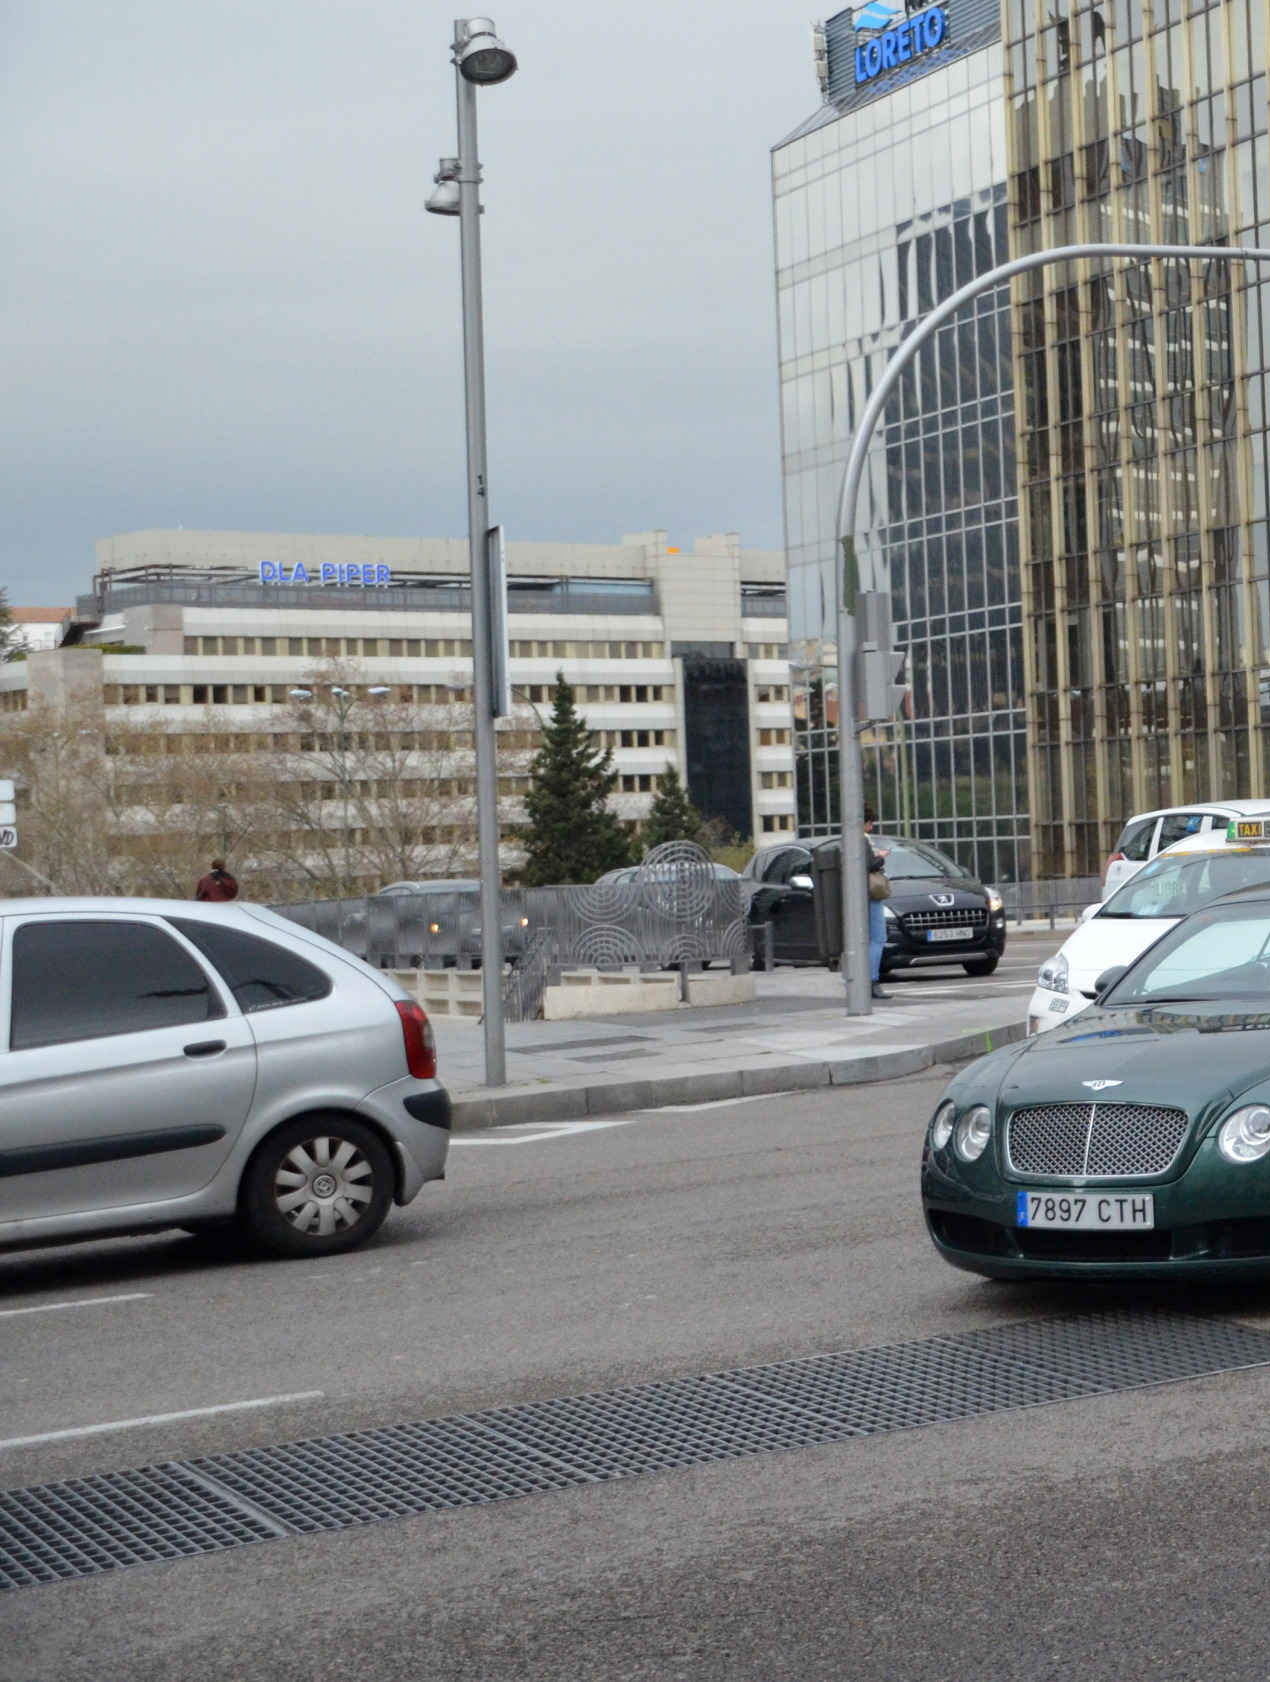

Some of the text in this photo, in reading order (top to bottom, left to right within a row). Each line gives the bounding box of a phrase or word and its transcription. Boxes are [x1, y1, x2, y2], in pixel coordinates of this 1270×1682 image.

[854, 6, 947, 84] LORETO
[259, 561, 391, 584] DLA PIPER
[1239, 823, 1262, 837] TAXI
[1156, 881, 1186, 897] LIBRE
[1030, 1197, 1087, 1223] 7897
[1098, 1199, 1147, 1223] CTH
